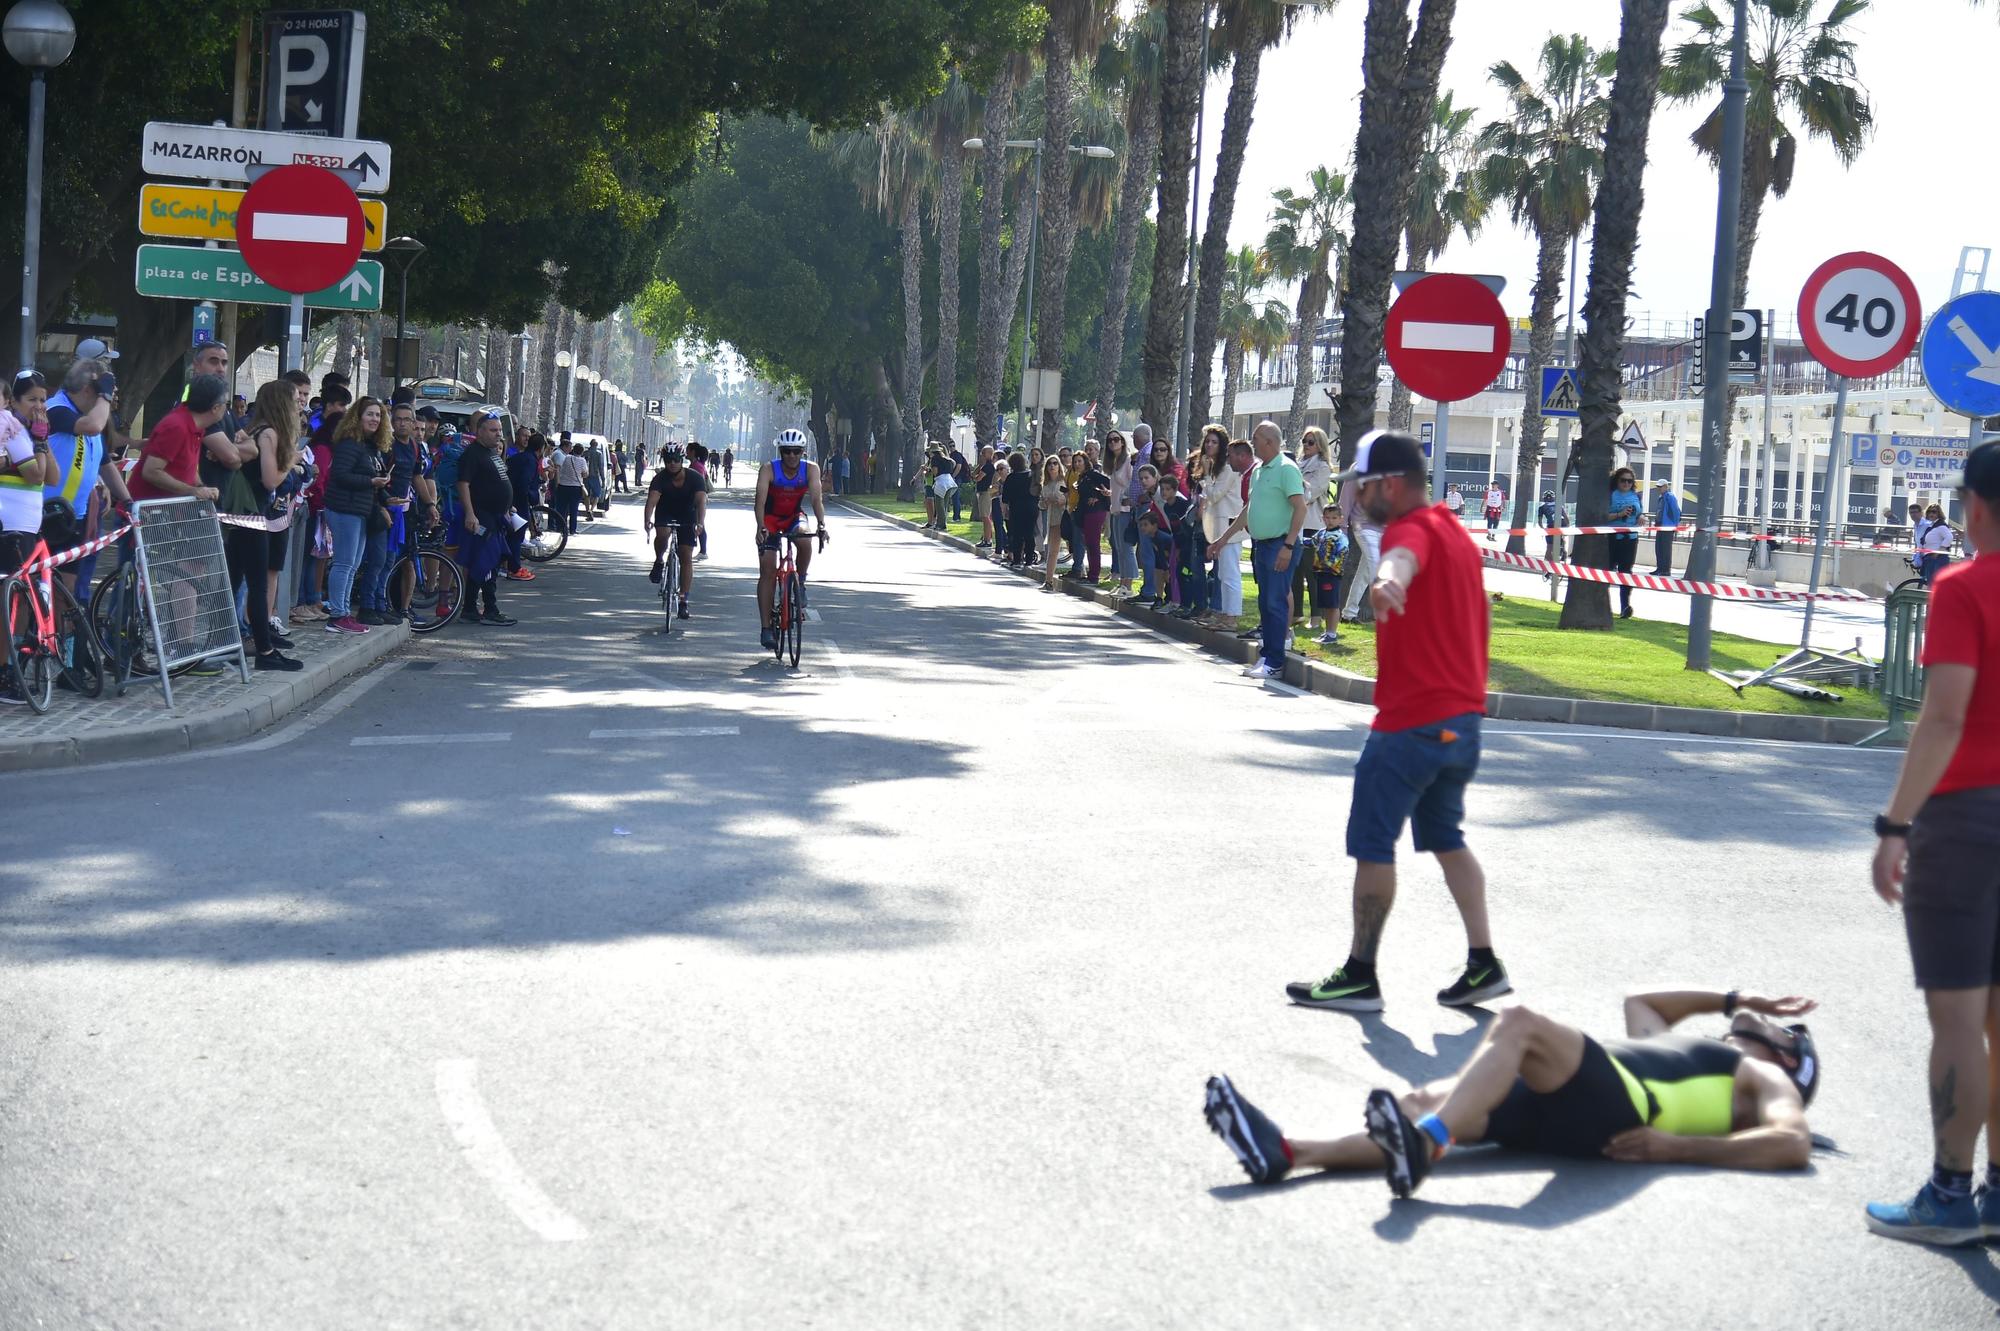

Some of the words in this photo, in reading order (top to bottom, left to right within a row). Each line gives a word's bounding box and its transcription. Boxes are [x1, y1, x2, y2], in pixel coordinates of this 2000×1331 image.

[295, 20, 306, 29] 24
[308, 18, 340, 29] HORAS
[279, 34, 330, 123] P
[152, 141, 262, 164] MAZARRÓN
[294, 154, 342, 168] N-332
[150, 198, 167, 217] El
[169, 200, 207, 220] Corte
[145, 266, 185, 279] plaza
[192, 270, 209, 280] de
[216, 266, 265, 287] Espa
[1825, 293, 1896, 338] 40
[648, 400, 660, 412] P
[1858, 437, 1873, 458] P
[1900, 437, 1949, 448] PARKING
[1952, 439, 1969, 448] del
[1920, 448, 1951, 457] Abierto
[1915, 456, 1969, 470] ENTRA
